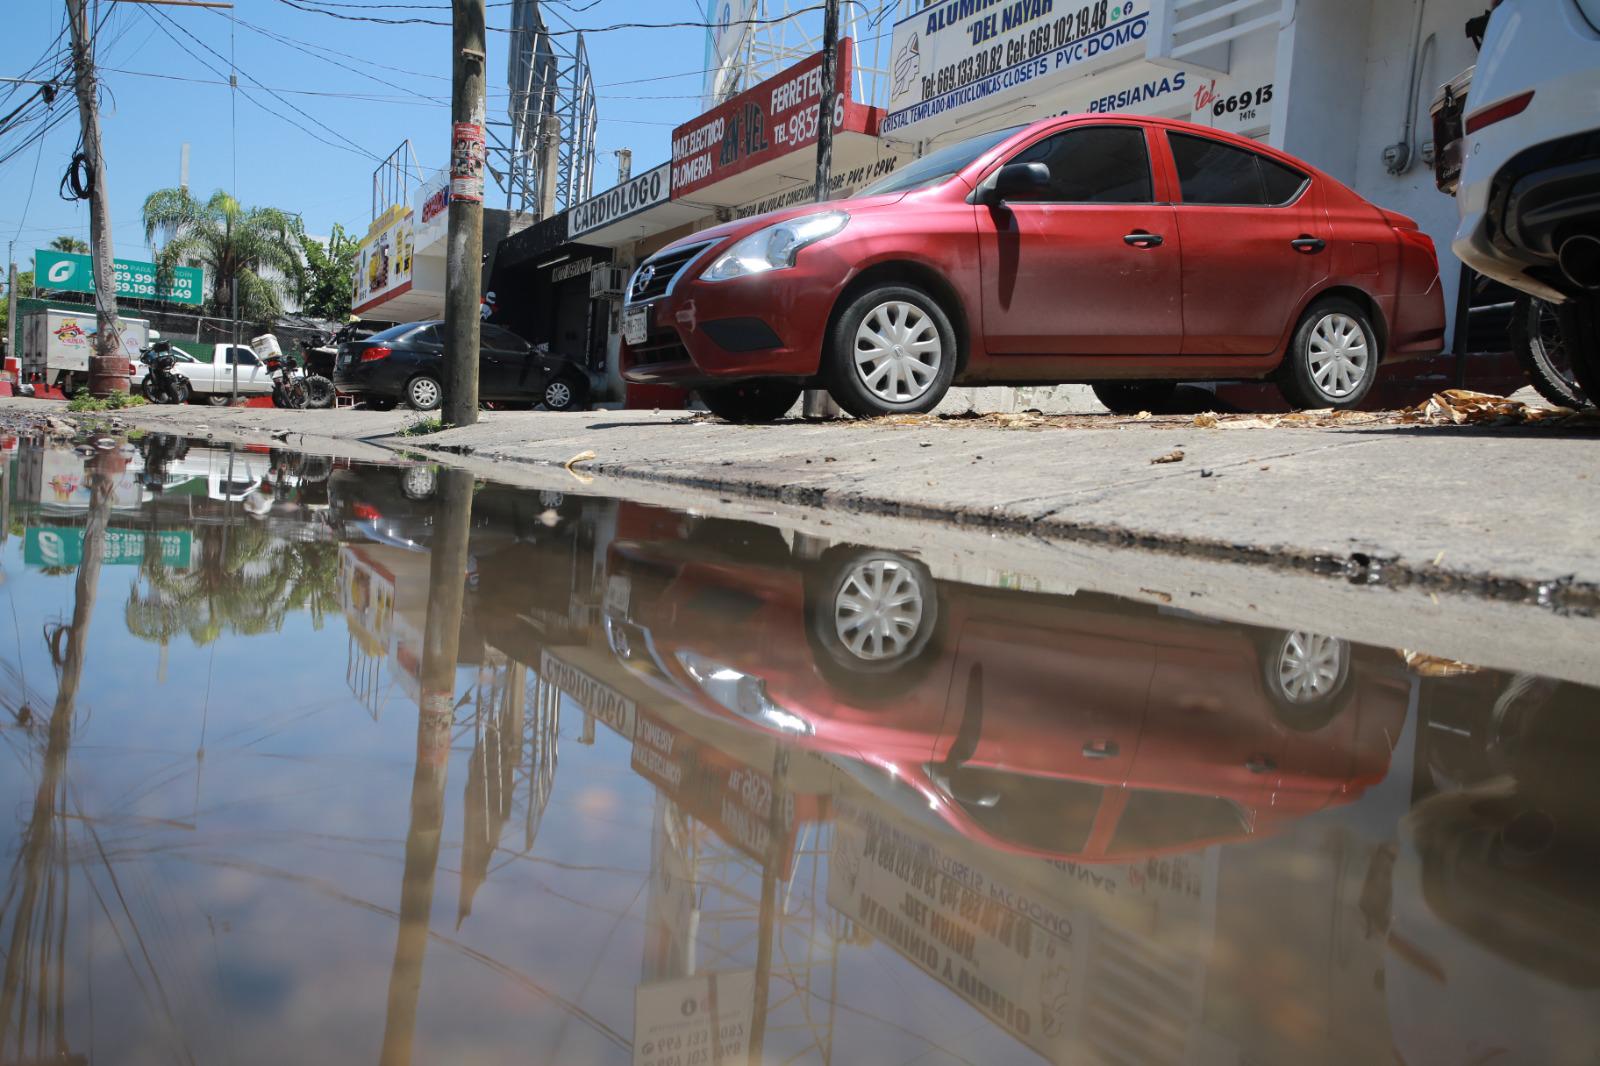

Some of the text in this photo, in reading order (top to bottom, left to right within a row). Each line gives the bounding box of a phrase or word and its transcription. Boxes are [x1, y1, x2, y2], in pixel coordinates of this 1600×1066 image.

[937, 43, 1003, 94] 669.133.30.82
[1006, 34, 1026, 67] Cel:
[1028, 0, 1108, 58] 669.102.19.48
[1003, 57, 1048, 89] CLOSETS
[1056, 43, 1083, 69] PVC
[1088, 19, 1149, 57] DOMO
[770, 64, 824, 117] FERRETER
[1089, 71, 1186, 115] PERSIANAS
[672, 151, 713, 191] PLOMERIA
[866, 164, 873, 180] Y
[574, 171, 661, 232] CARDIOLOGO
